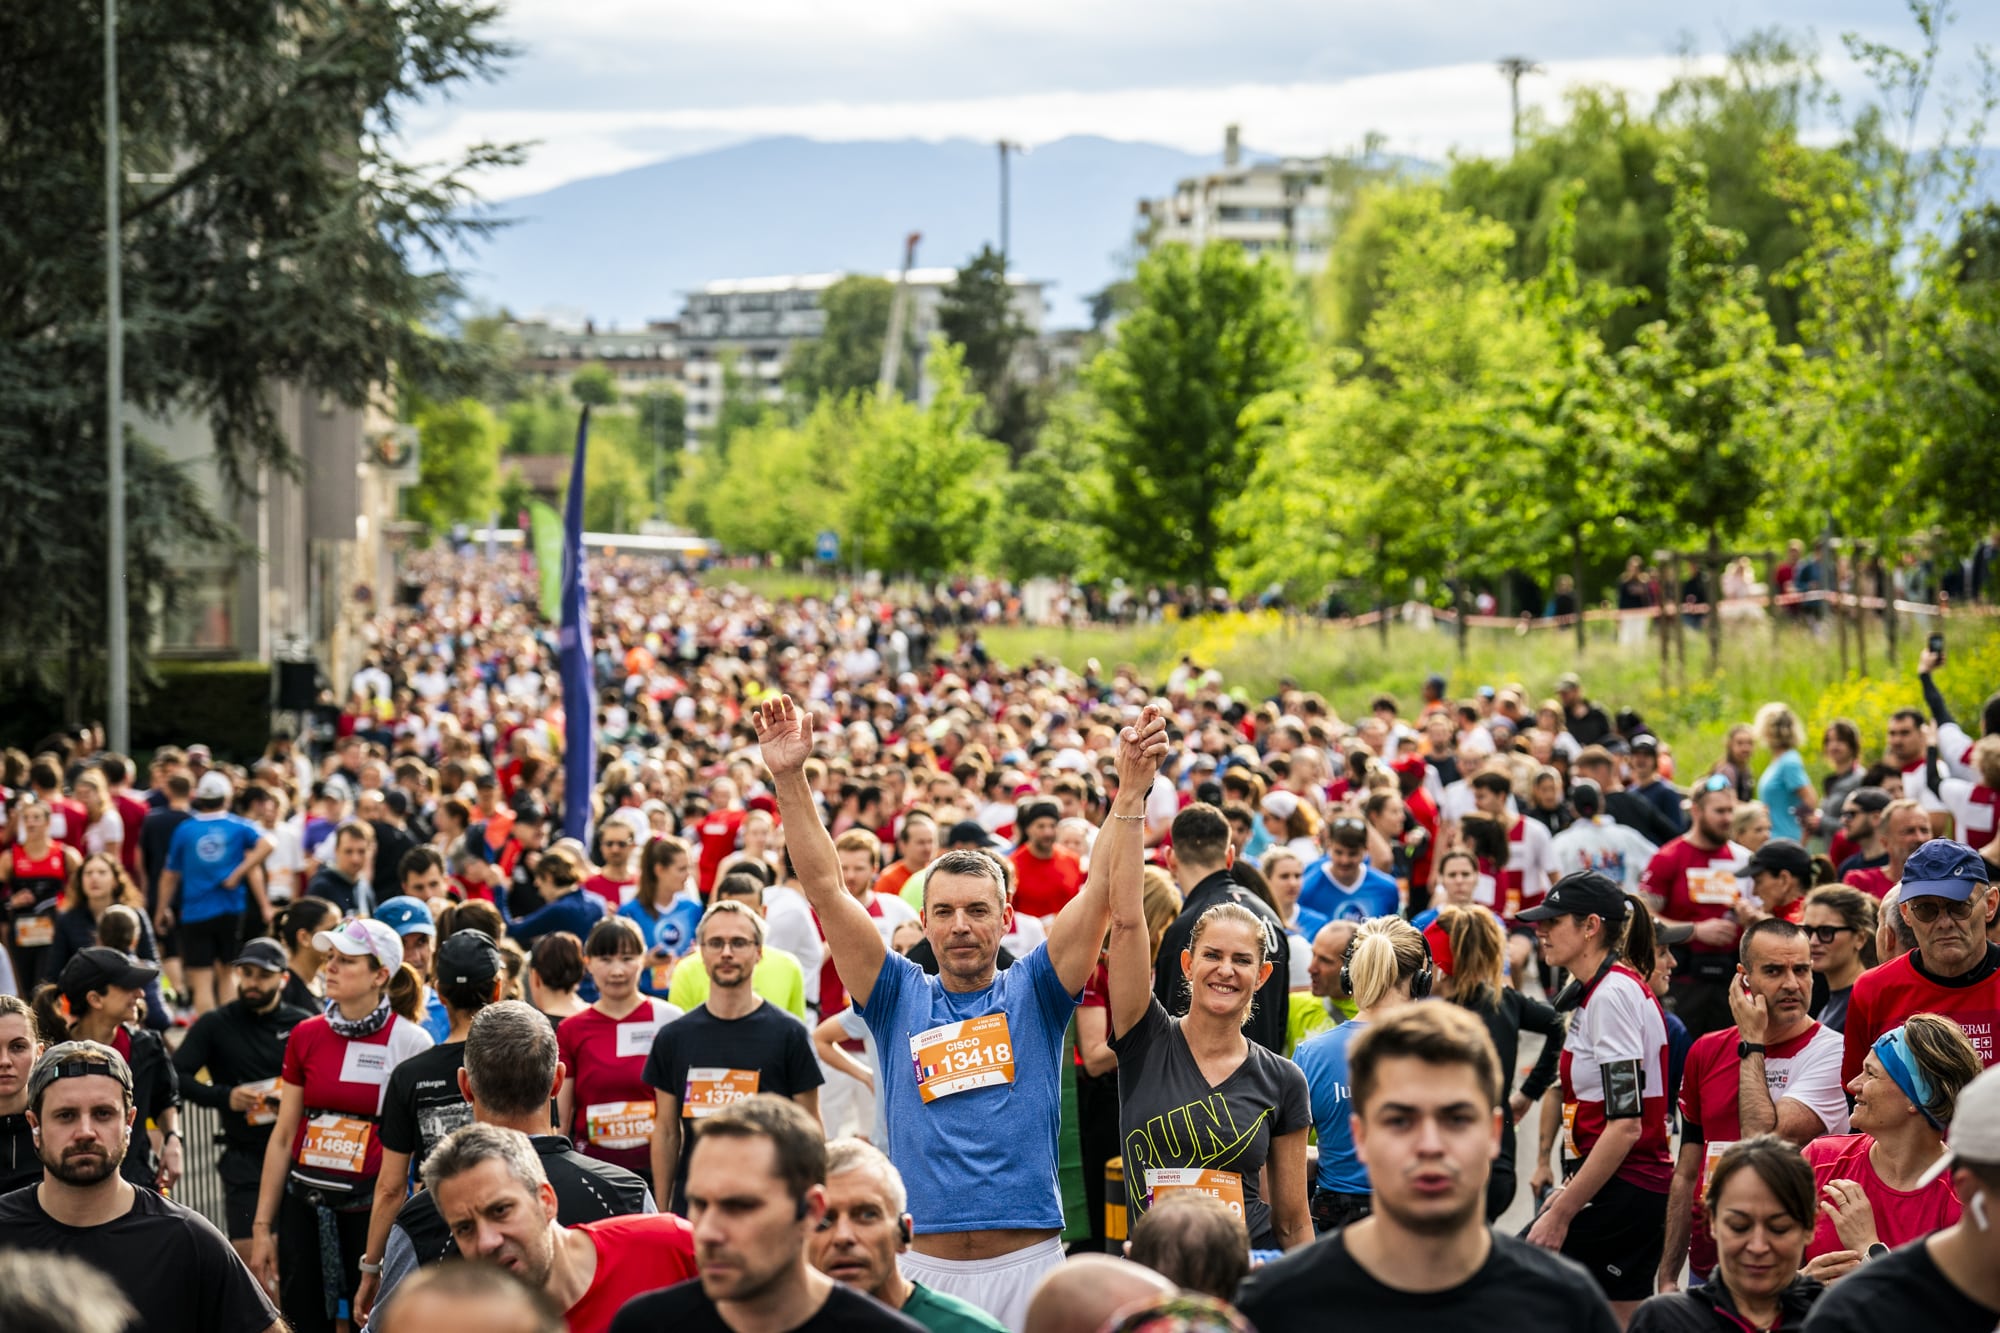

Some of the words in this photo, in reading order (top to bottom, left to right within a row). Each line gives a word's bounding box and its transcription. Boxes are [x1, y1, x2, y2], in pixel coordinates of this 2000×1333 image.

[1960, 1023, 1991, 1035] ERALI
[946, 1037, 980, 1052] CISCO
[940, 1043, 1011, 1073] 13418
[1333, 1081, 1352, 1103] Ju
[315, 1136, 365, 1157] 14682
[1126, 1092, 1241, 1200] RUN
